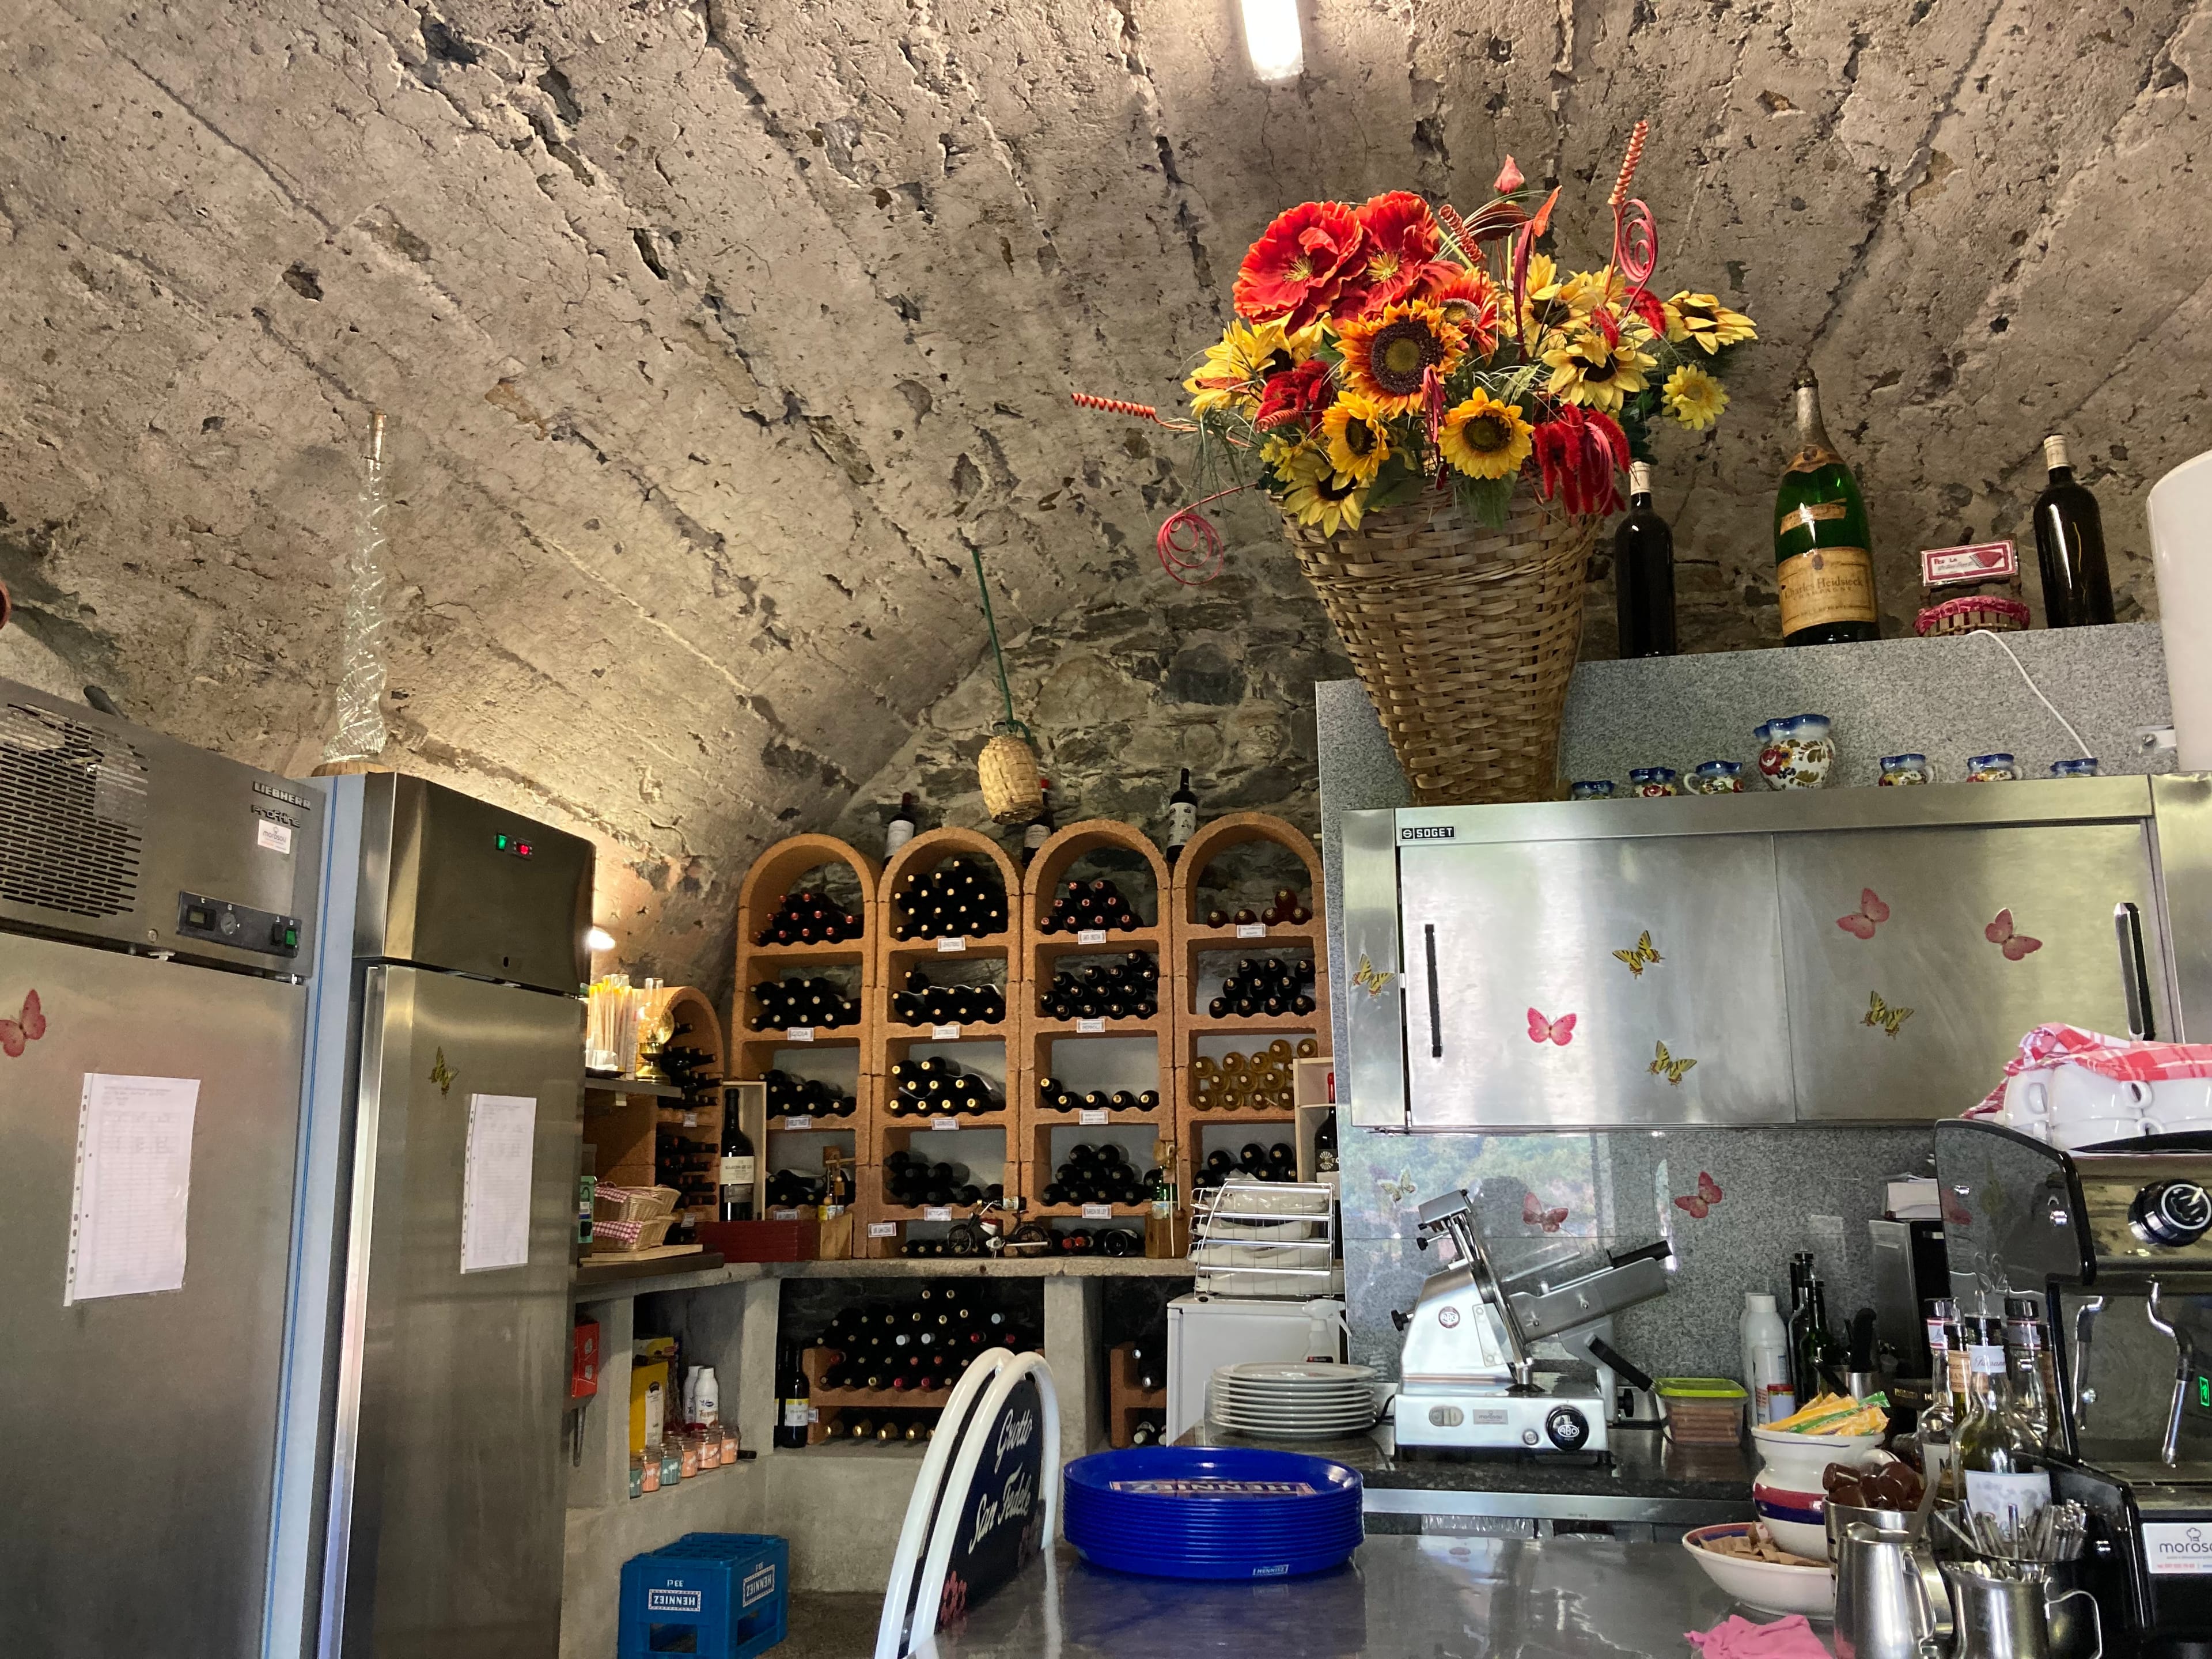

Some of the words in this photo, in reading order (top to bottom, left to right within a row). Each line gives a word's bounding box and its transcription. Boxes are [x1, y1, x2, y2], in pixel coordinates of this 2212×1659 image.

[1785, 582, 1815, 600] Charles
[1817, 576, 1863, 589] Heidsieck
[253, 782, 310, 809] LIEBHERR
[1416, 828, 1452, 838] SOGET
[994, 1408, 1033, 1474] Grotto
[968, 1493, 998, 1555] San
[2159, 1543, 2212, 1553] moros
[746, 1574, 772, 1597] HENNIEZ
[653, 1595, 695, 1606] HENNIEZ
